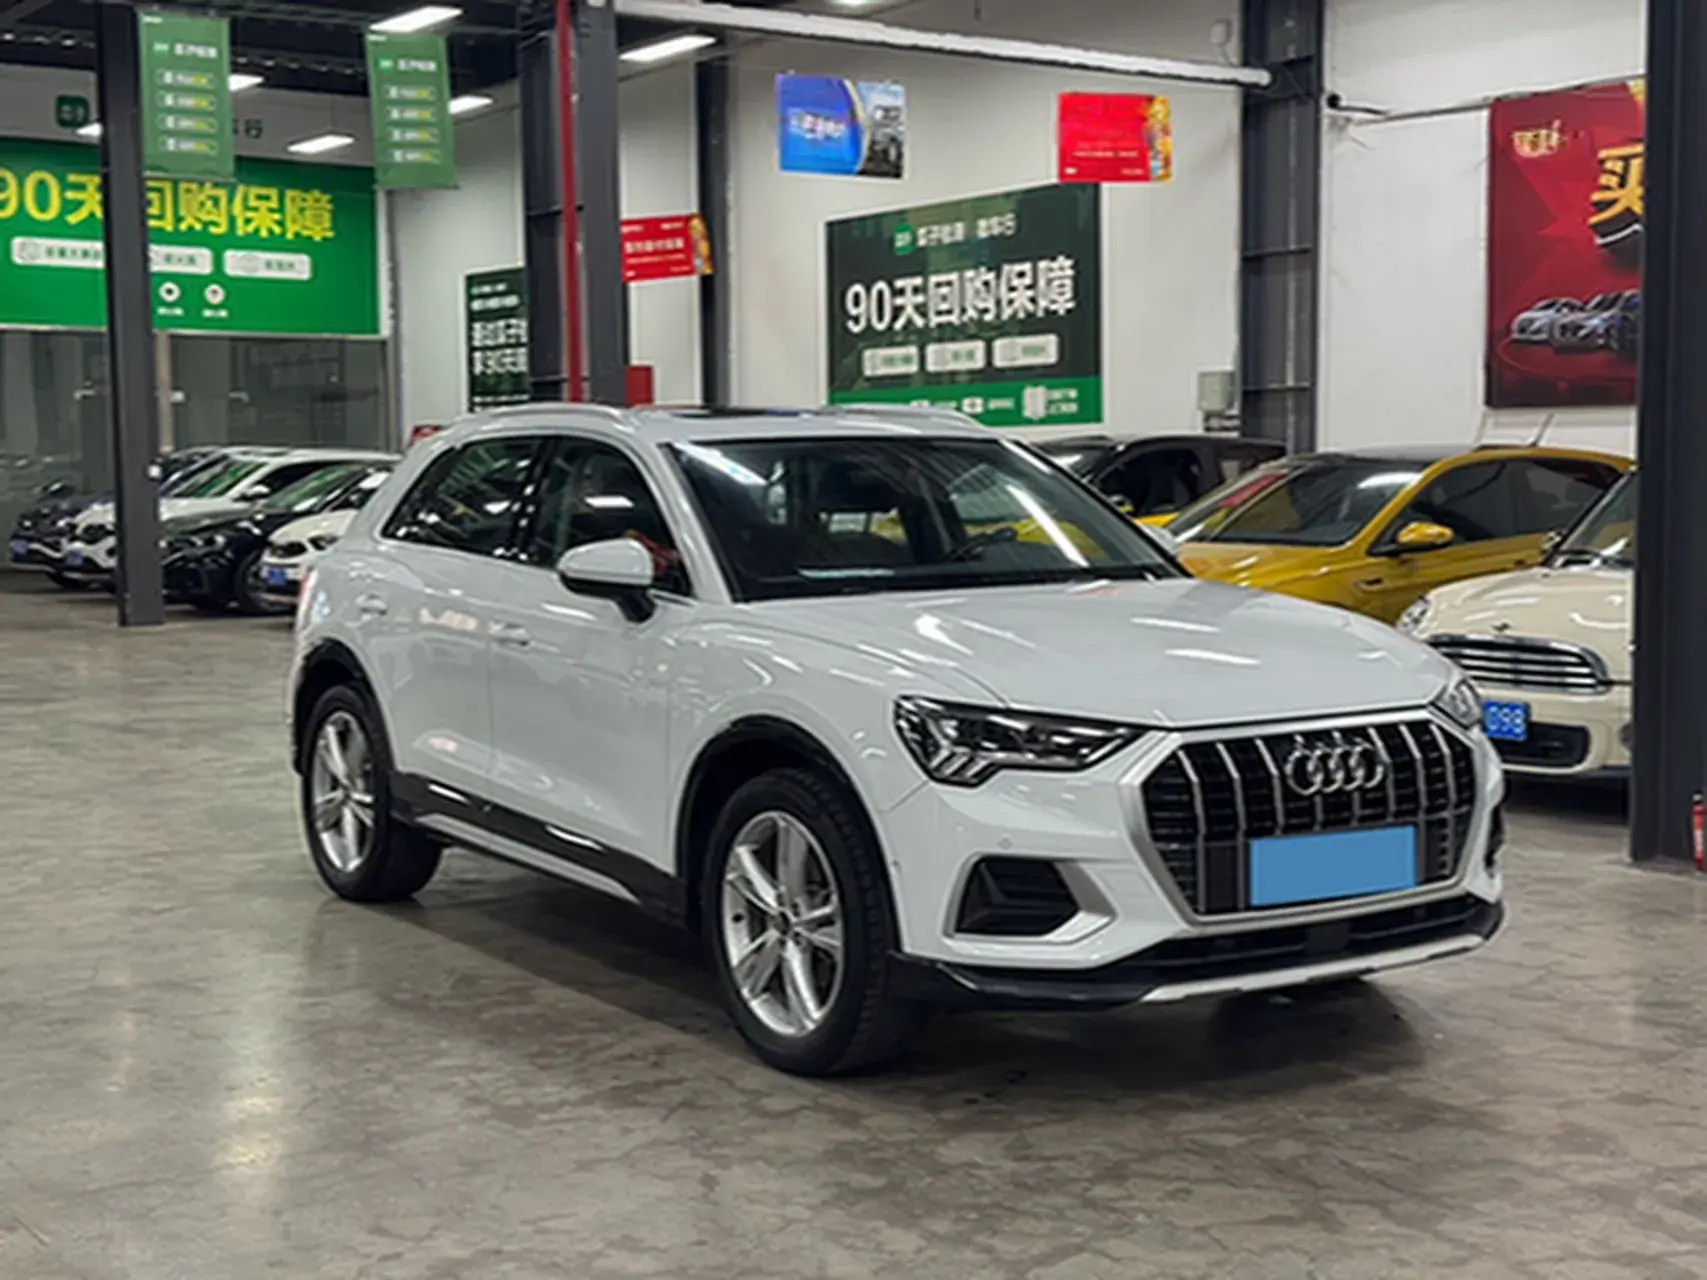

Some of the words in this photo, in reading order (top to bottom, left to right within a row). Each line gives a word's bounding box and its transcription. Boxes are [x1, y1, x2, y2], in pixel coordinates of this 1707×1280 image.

[845, 255, 1076, 333] 90天回购保障
